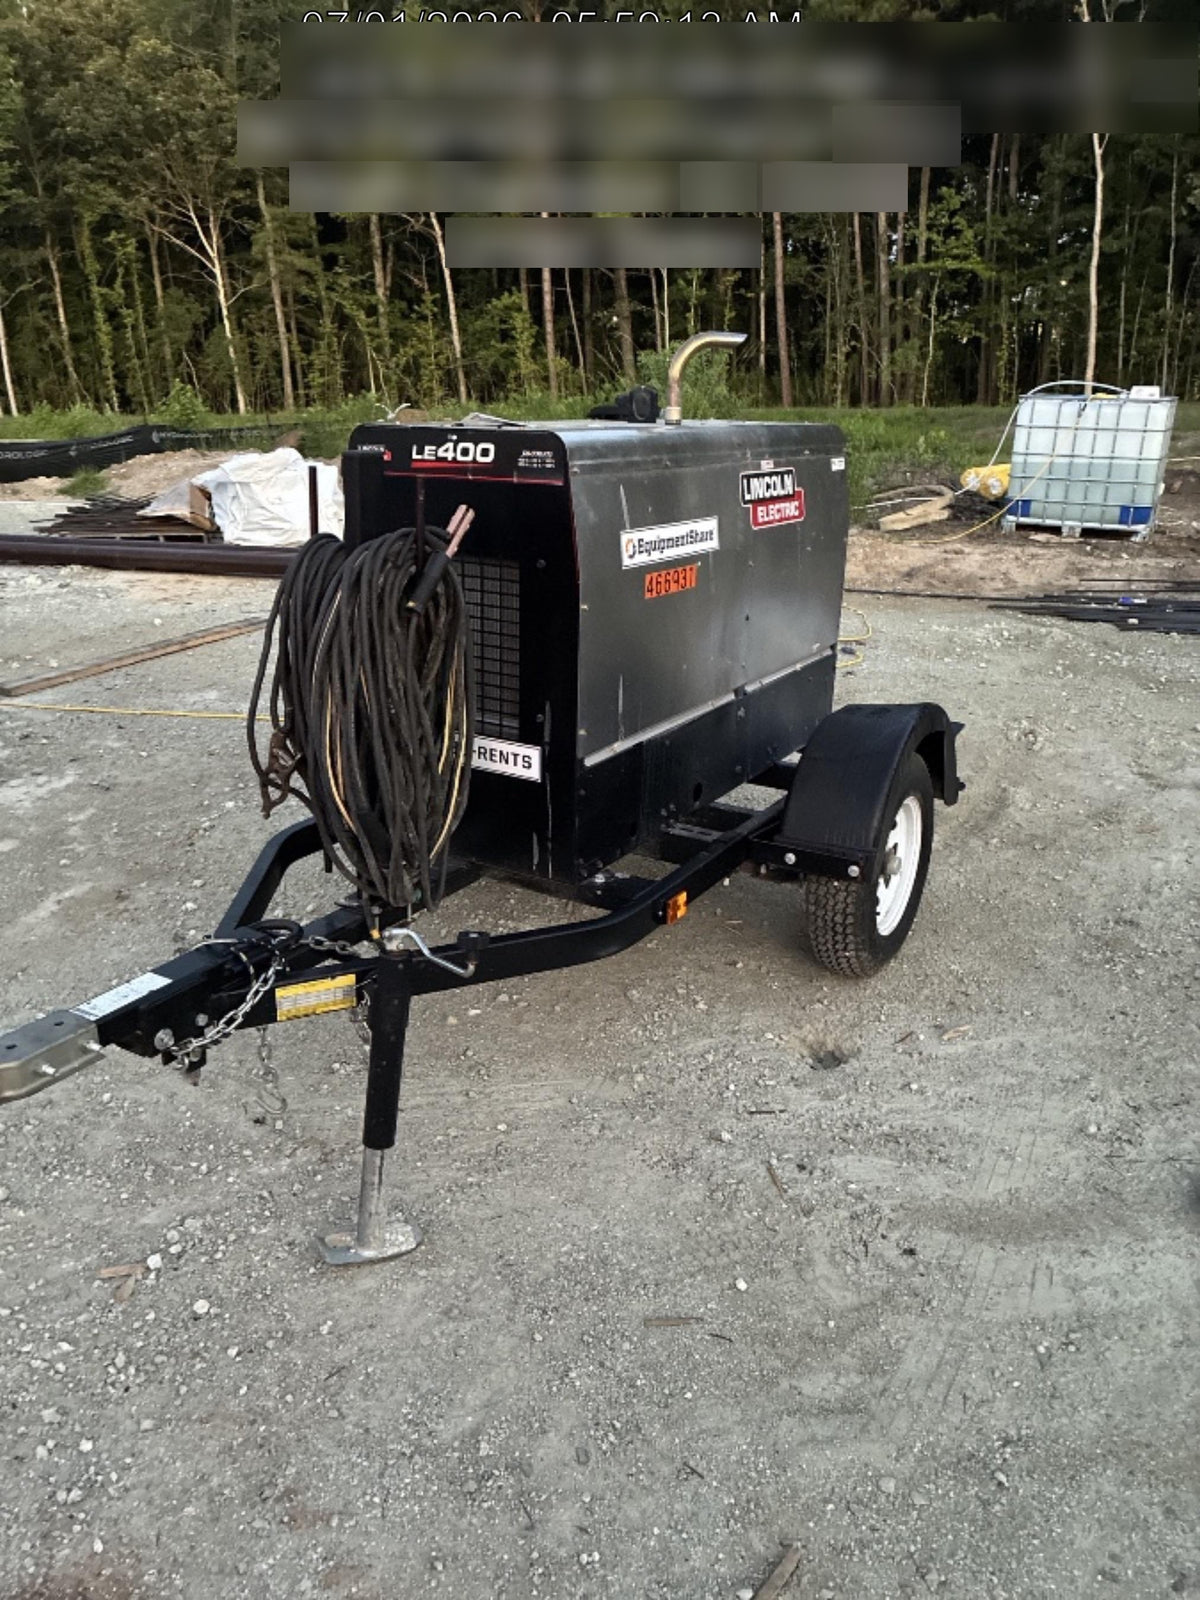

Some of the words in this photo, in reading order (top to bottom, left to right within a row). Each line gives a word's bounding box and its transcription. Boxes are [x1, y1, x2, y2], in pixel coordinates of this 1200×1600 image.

[412, 441, 495, 463] LE400
[743, 473, 793, 501] LINCOLN
[757, 501, 799, 523] ELECTRIC
[637, 529, 714, 557] EquipmentShare
